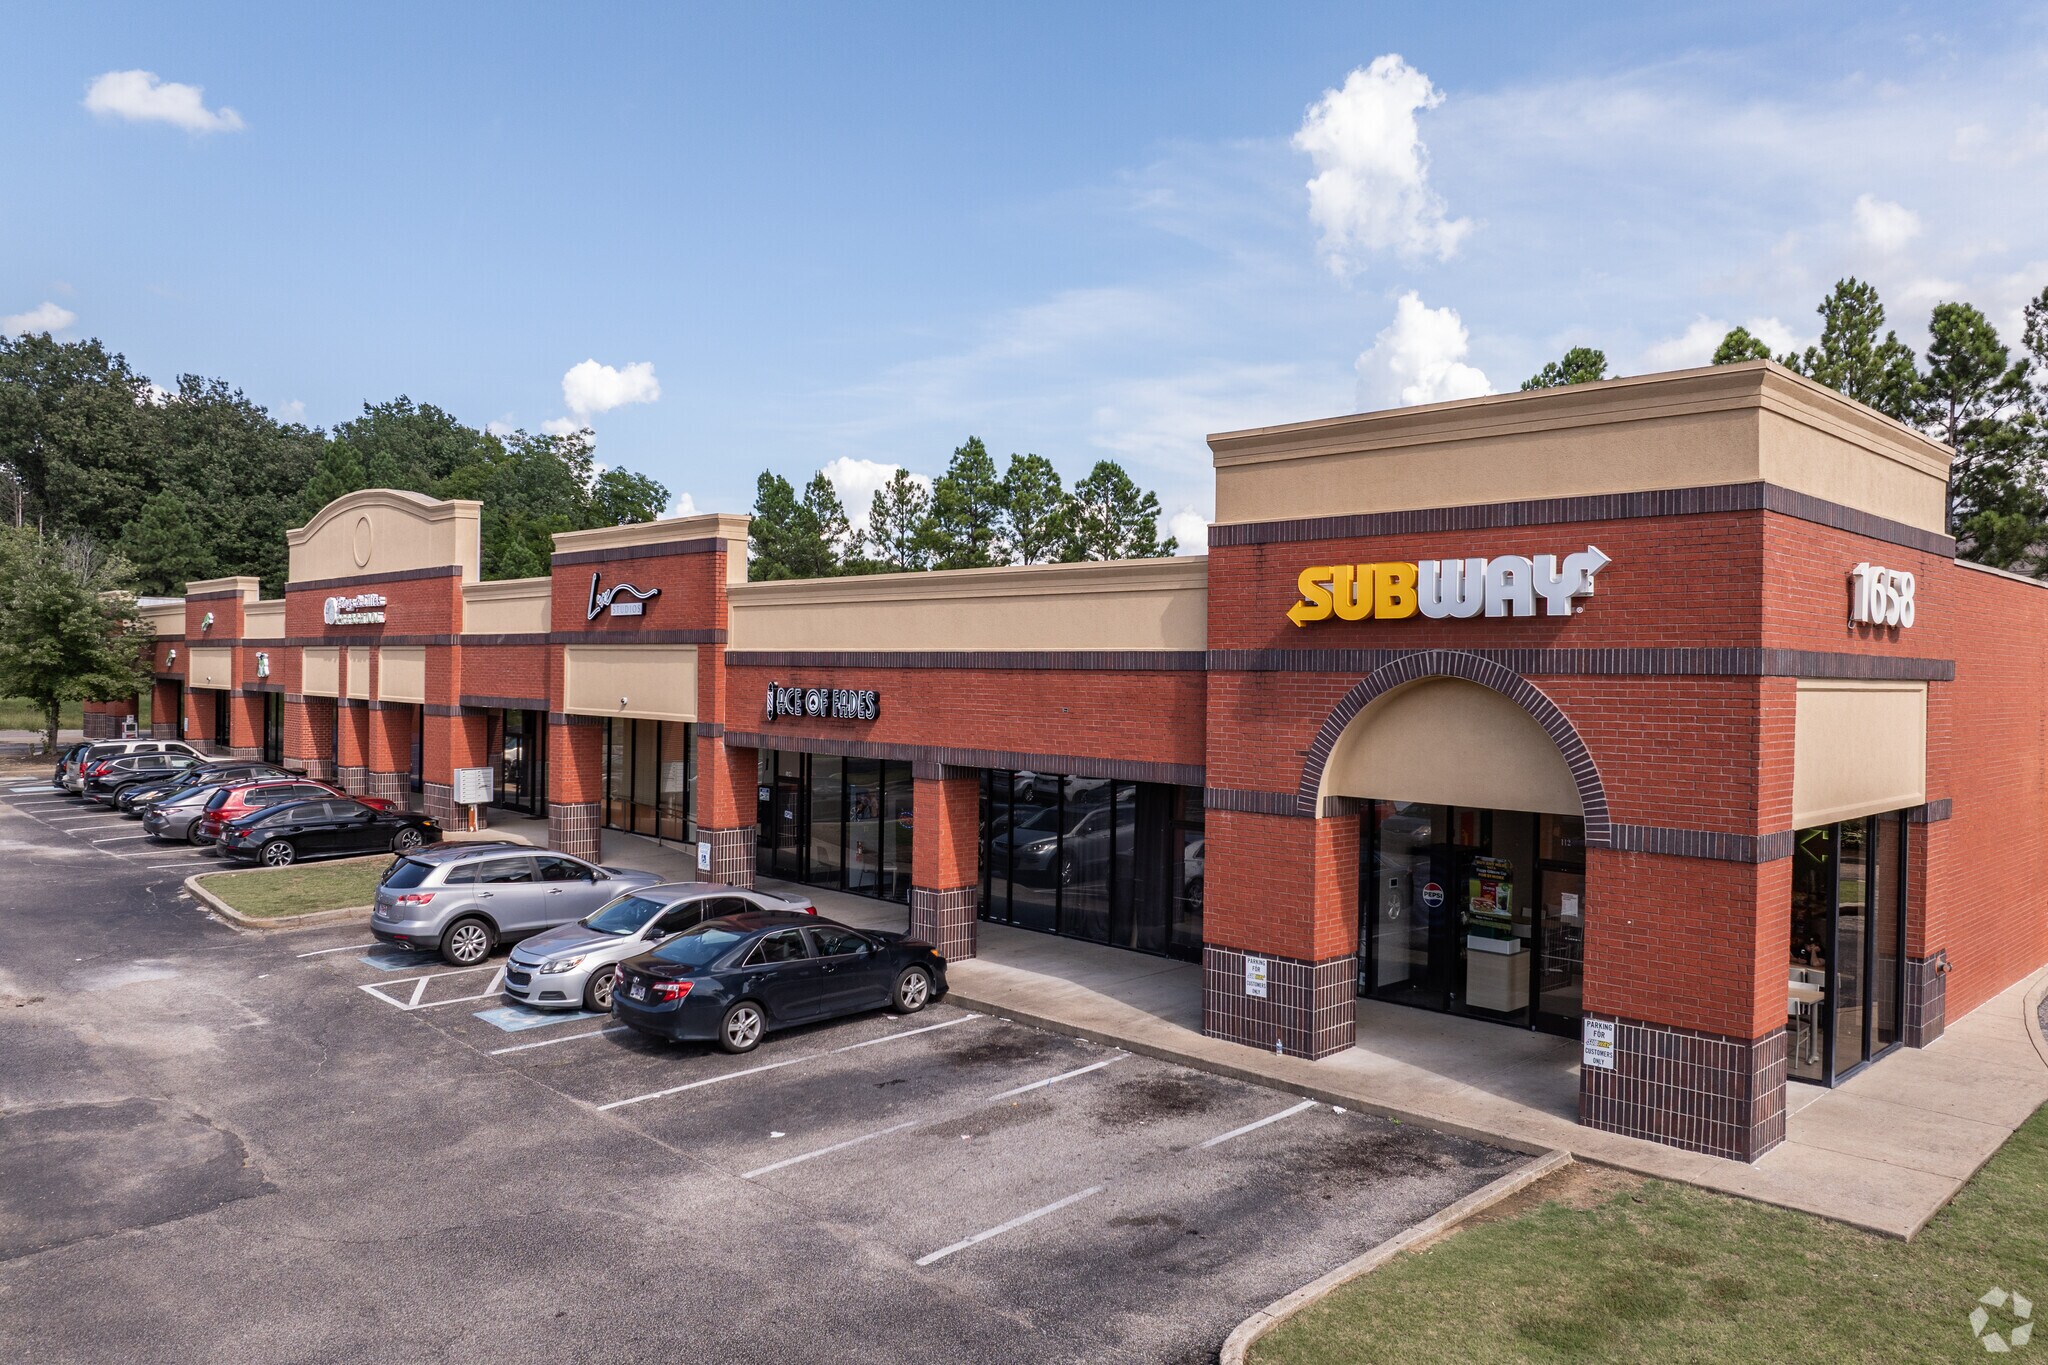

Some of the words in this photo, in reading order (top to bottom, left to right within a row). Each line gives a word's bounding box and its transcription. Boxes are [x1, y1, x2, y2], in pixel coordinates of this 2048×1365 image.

[1286, 544, 1612, 628] SUBWAY
[1852, 562, 1916, 629] 1658
[612, 604, 641, 615] STUDIOS
[776, 687, 802, 716] ACE
[805, 688, 829, 718] OF
[832, 689, 877, 720] FADES
[1424, 891, 1443, 899] PEPSI
[1247, 958, 1265, 966] PARKING
[1247, 980, 1266, 989] CUSTOMERS
[1587, 1021, 1613, 1031] PARKING
[1585, 1048, 1613, 1058] CUSTOMERS
